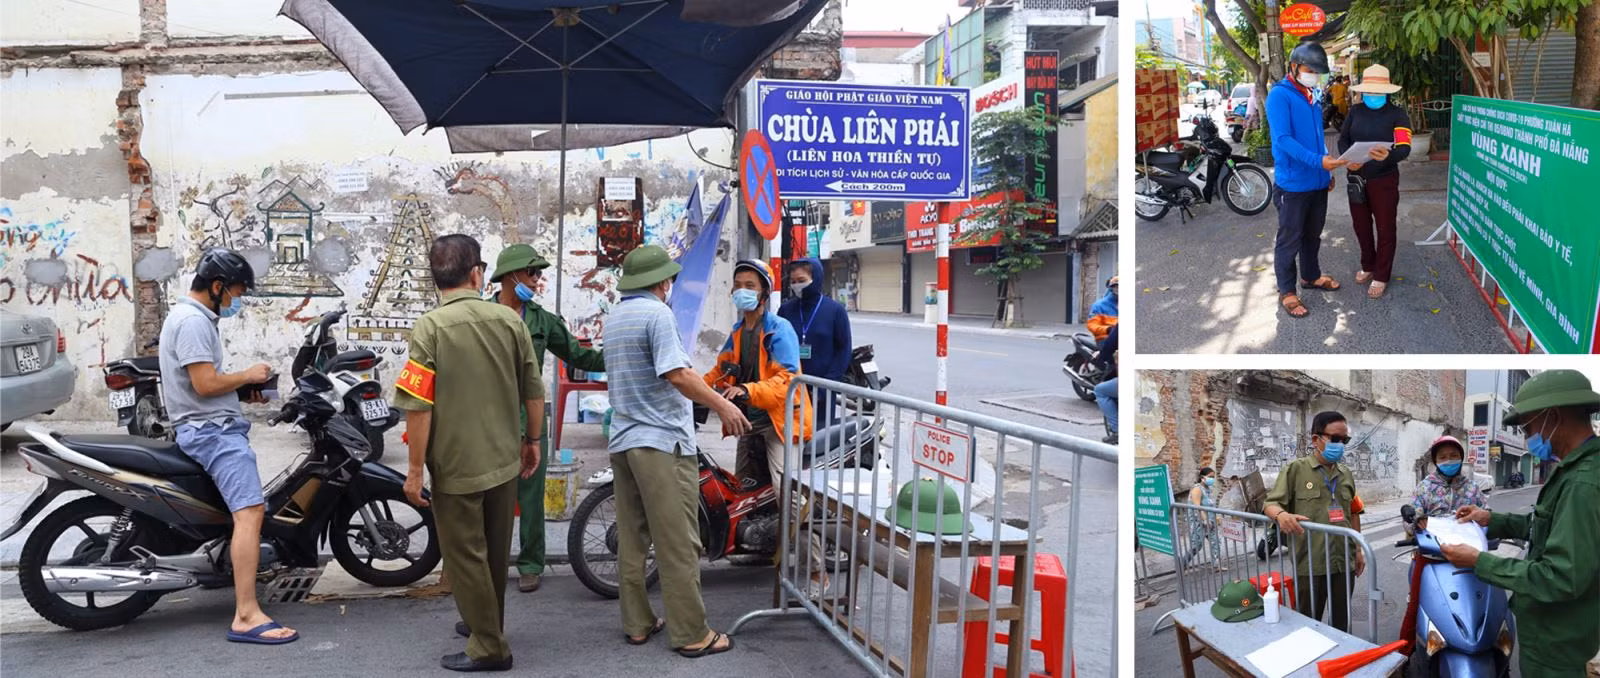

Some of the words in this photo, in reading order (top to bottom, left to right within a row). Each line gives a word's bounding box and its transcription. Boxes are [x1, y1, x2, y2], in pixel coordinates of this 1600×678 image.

[786, 90, 812, 100] GIÁO
[815, 90, 833, 102] HỘI
[836, 91, 865, 103] PHẬT
[867, 93, 892, 104] GIÁO
[895, 94, 919, 105] VIỆT
[921, 96, 943, 105] NAM
[975, 82, 1018, 113] BOSCH
[767, 107, 837, 143] CHÙA
[842, 109, 897, 145] LIÊN
[903, 112, 960, 147] PHÁI
[1544, 119, 1561, 134] XUÂN
[1562, 121, 1571, 137] HÀ
[1471, 131, 1498, 156] VÙNG
[1500, 142, 1541, 177] XANH
[1514, 127, 1534, 145] THÀNH
[1534, 132, 1548, 151] PHỐ
[1549, 137, 1560, 155] ĐÀ
[1562, 138, 1589, 164] NẴNG
[787, 147, 827, 163] (LIÊN
[832, 151, 863, 163] HOA
[917, 152, 941, 167] TỰ)
[776, 168, 785, 177] DI
[787, 167, 808, 177] TÍCH
[809, 169, 830, 179] LỊCH
[832, 167, 845, 178] SỬ
[851, 168, 870, 179] VĂN
[871, 170, 889, 179] HÓA
[891, 168, 908, 179] CẤP
[910, 169, 935, 180] QUỐC
[936, 172, 951, 180] GIA
[841, 183, 869, 191] Cách
[873, 183, 904, 191] 200m
[1524, 215, 1539, 237] KHAI
[1540, 227, 1553, 248] BÁO
[1555, 239, 1560, 253] Y
[1561, 244, 1573, 267] TẾ,
[1545, 298, 1557, 320] GIA
[1558, 312, 1580, 345] ĐÌNH
[410, 373, 423, 390] VỆ
[928, 430, 951, 445] POLICE
[923, 444, 955, 466] STOP
